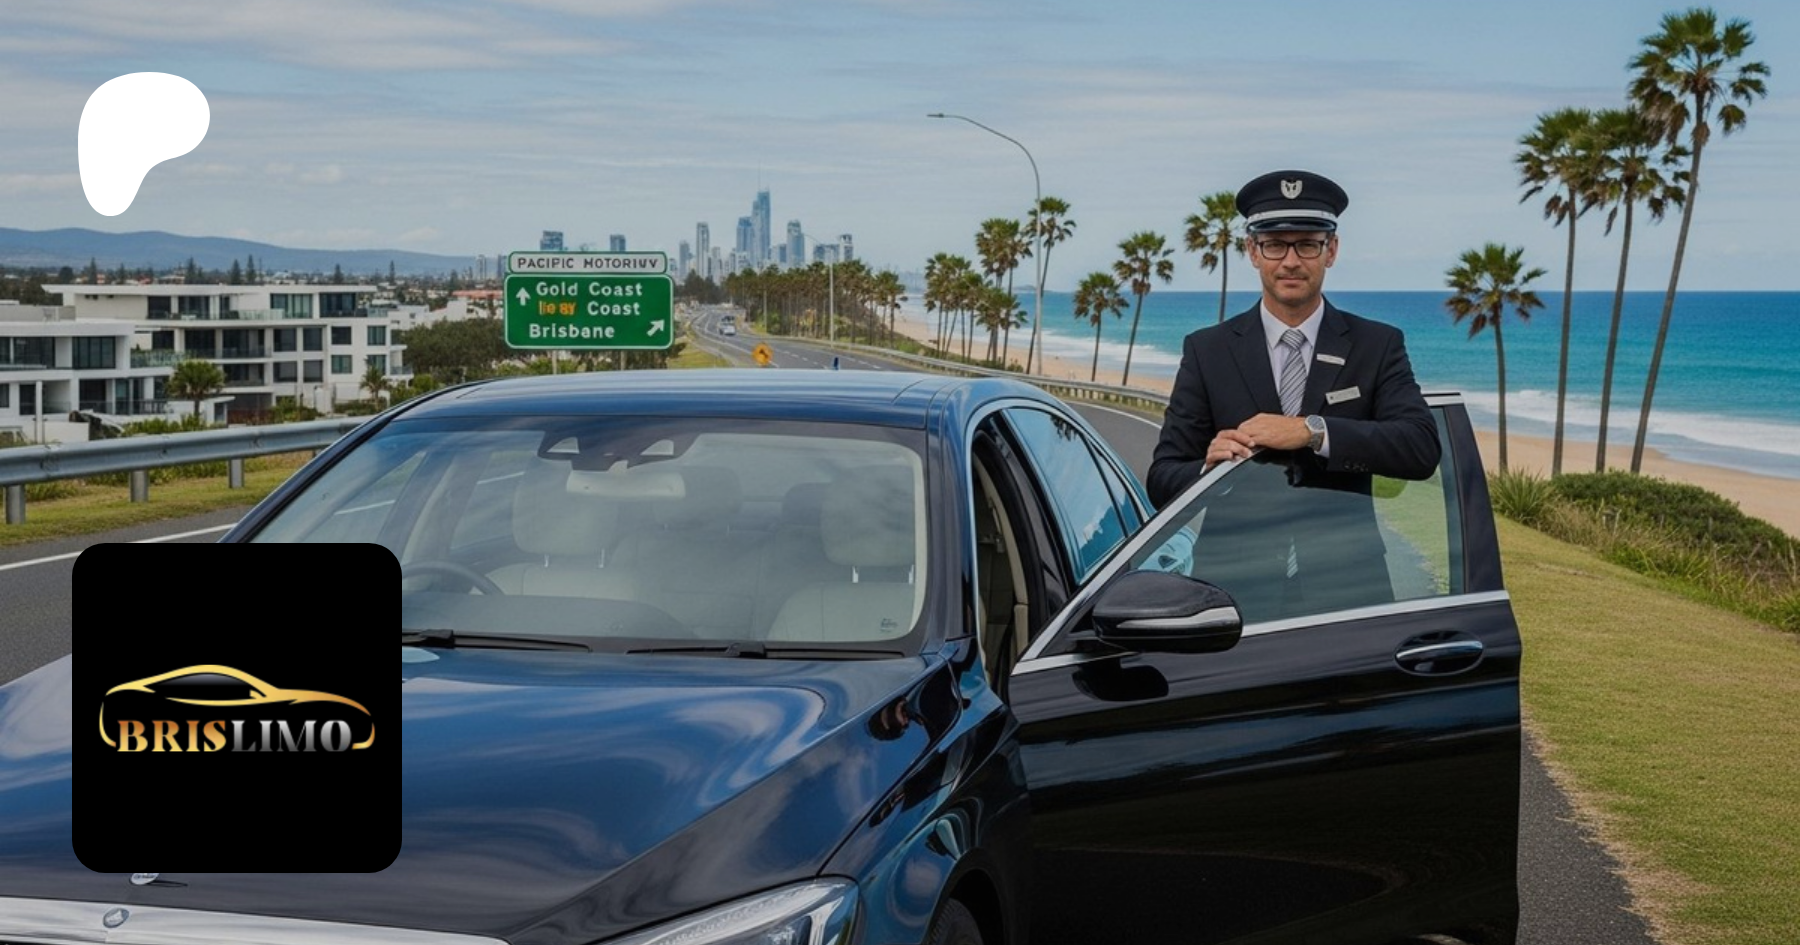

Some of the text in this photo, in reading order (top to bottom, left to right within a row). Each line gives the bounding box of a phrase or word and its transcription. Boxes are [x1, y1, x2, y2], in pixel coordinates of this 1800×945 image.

[536, 281, 643, 296] Gold Coast
[587, 301, 641, 316] Coast
[529, 323, 616, 339] Brisbane
